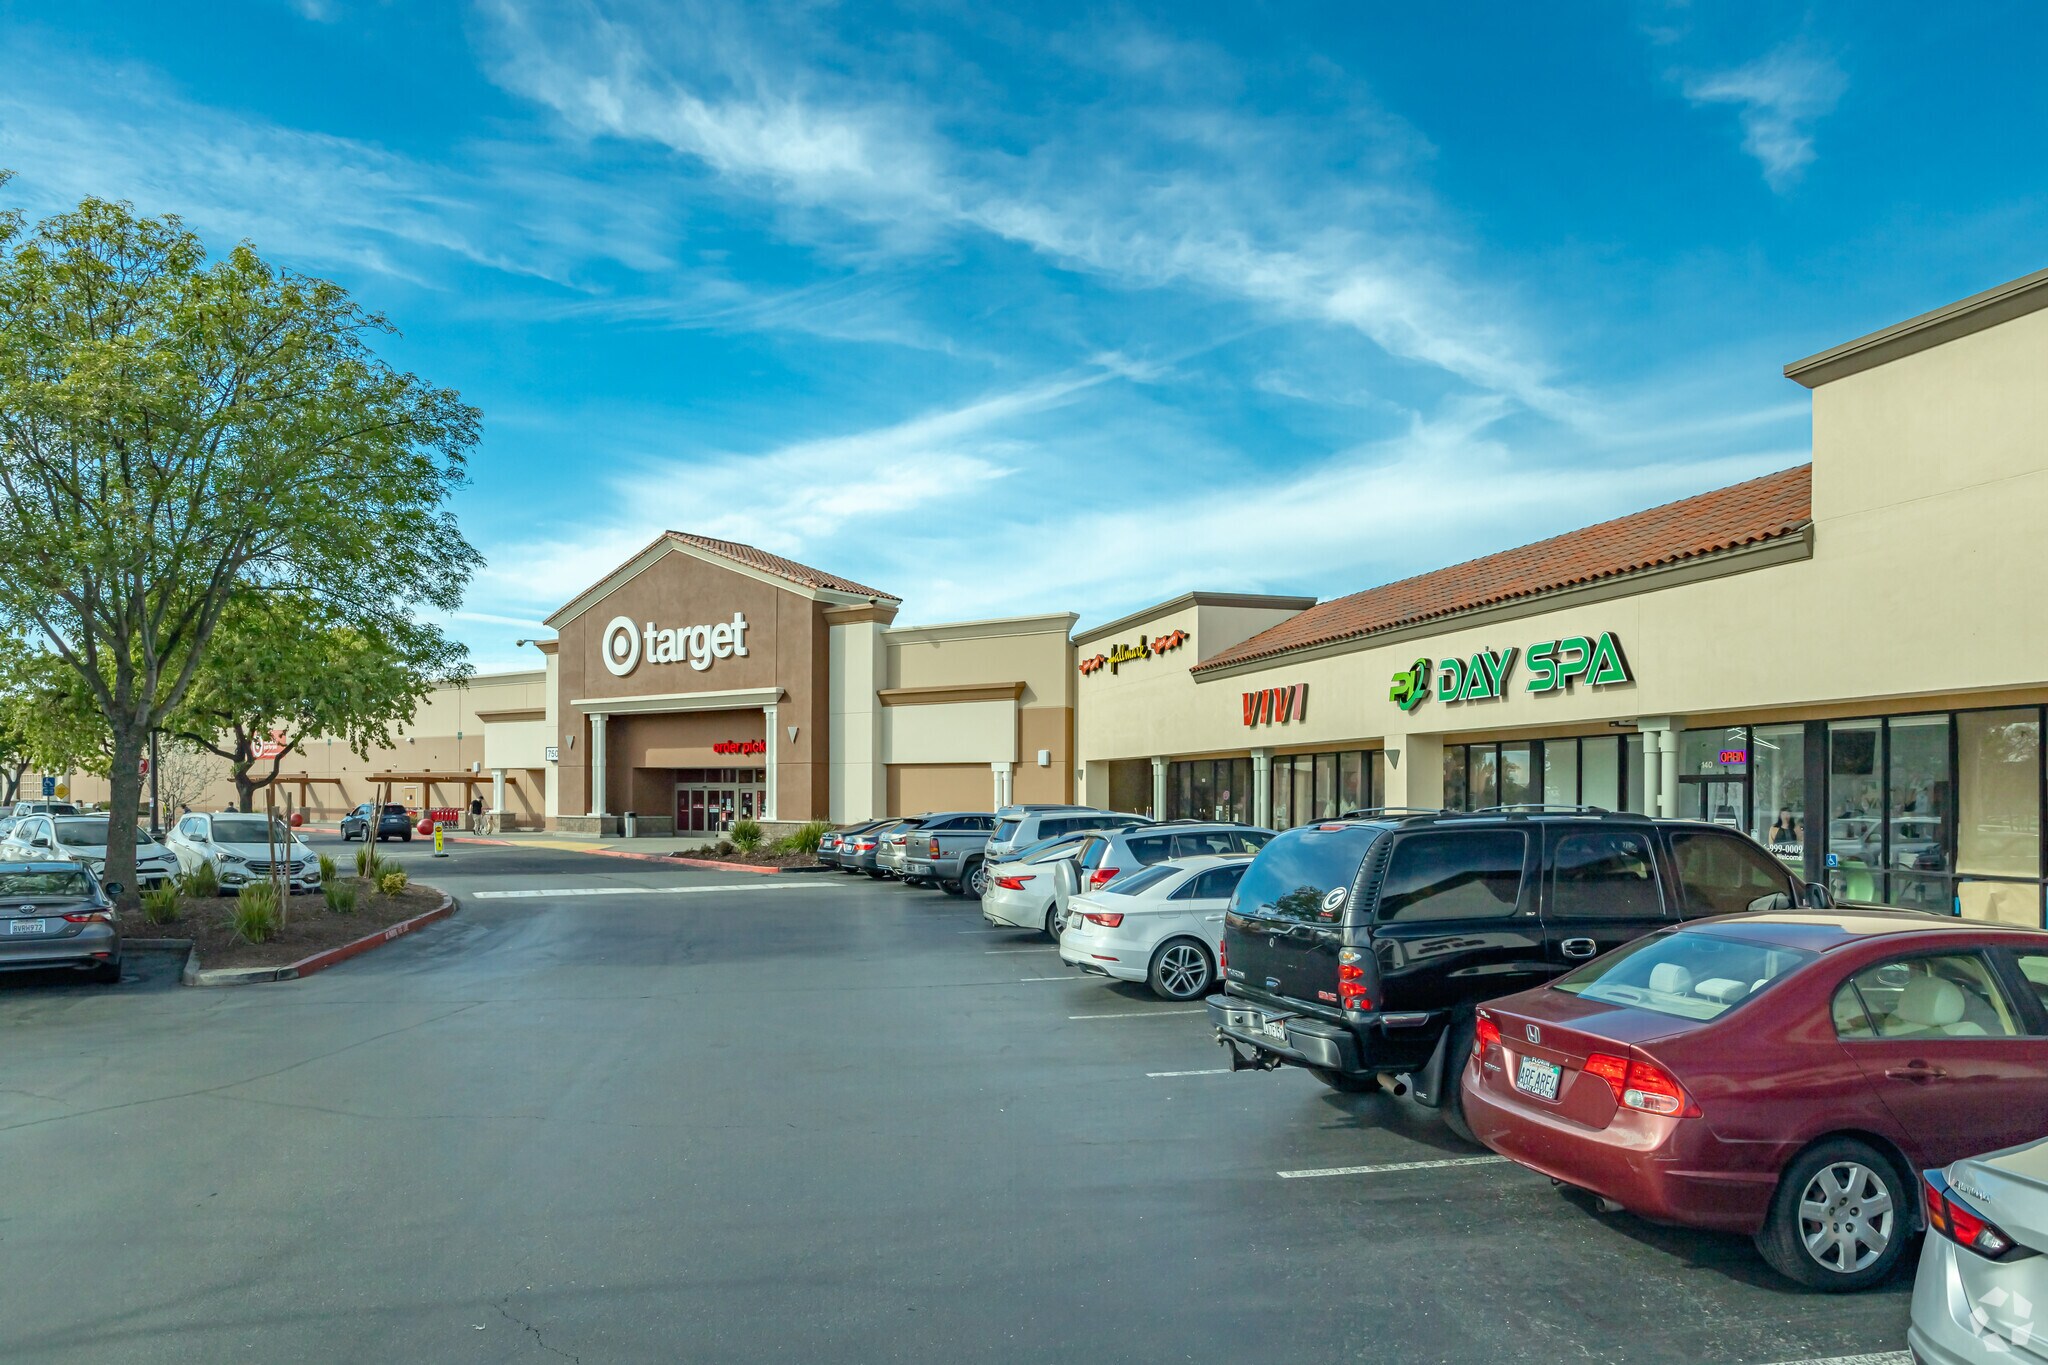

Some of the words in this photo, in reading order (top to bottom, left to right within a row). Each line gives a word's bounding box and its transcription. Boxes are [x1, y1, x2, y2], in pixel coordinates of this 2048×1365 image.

[643, 612, 748, 671] target
[1107, 635, 1150, 674] Hallmark
[1437, 647, 1514, 703] DAY
[1525, 631, 1629, 693] SPA
[1242, 683, 1307, 727] VIVI
[713, 740, 741, 753] order
[1701, 760, 1713, 769] 140
[1720, 751, 1745, 763] OPEN
